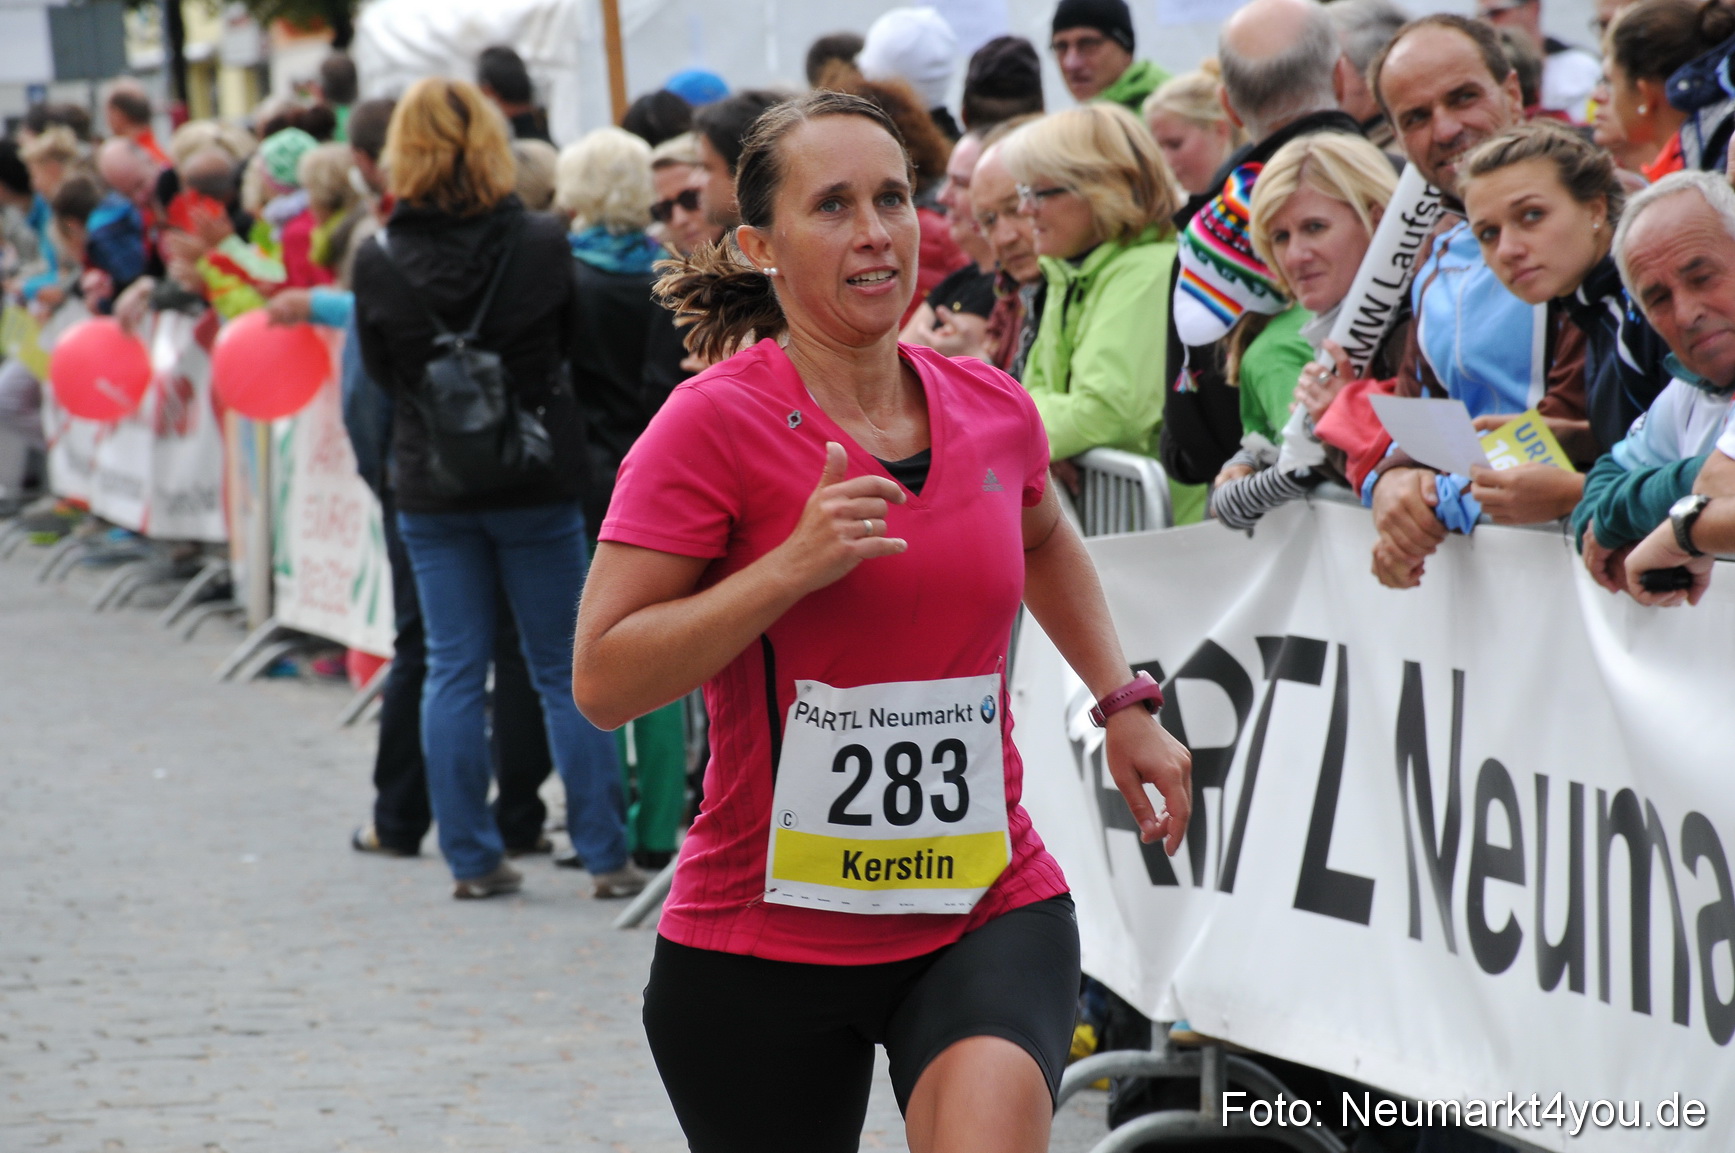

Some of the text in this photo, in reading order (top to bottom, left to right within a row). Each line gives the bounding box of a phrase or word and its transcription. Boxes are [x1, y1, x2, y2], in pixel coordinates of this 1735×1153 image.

[795, 700, 973, 731] PARTL Neumarkt
[827, 737, 970, 827] 283
[783, 812, 792, 827] C
[841, 848, 954, 882] Kerstin
